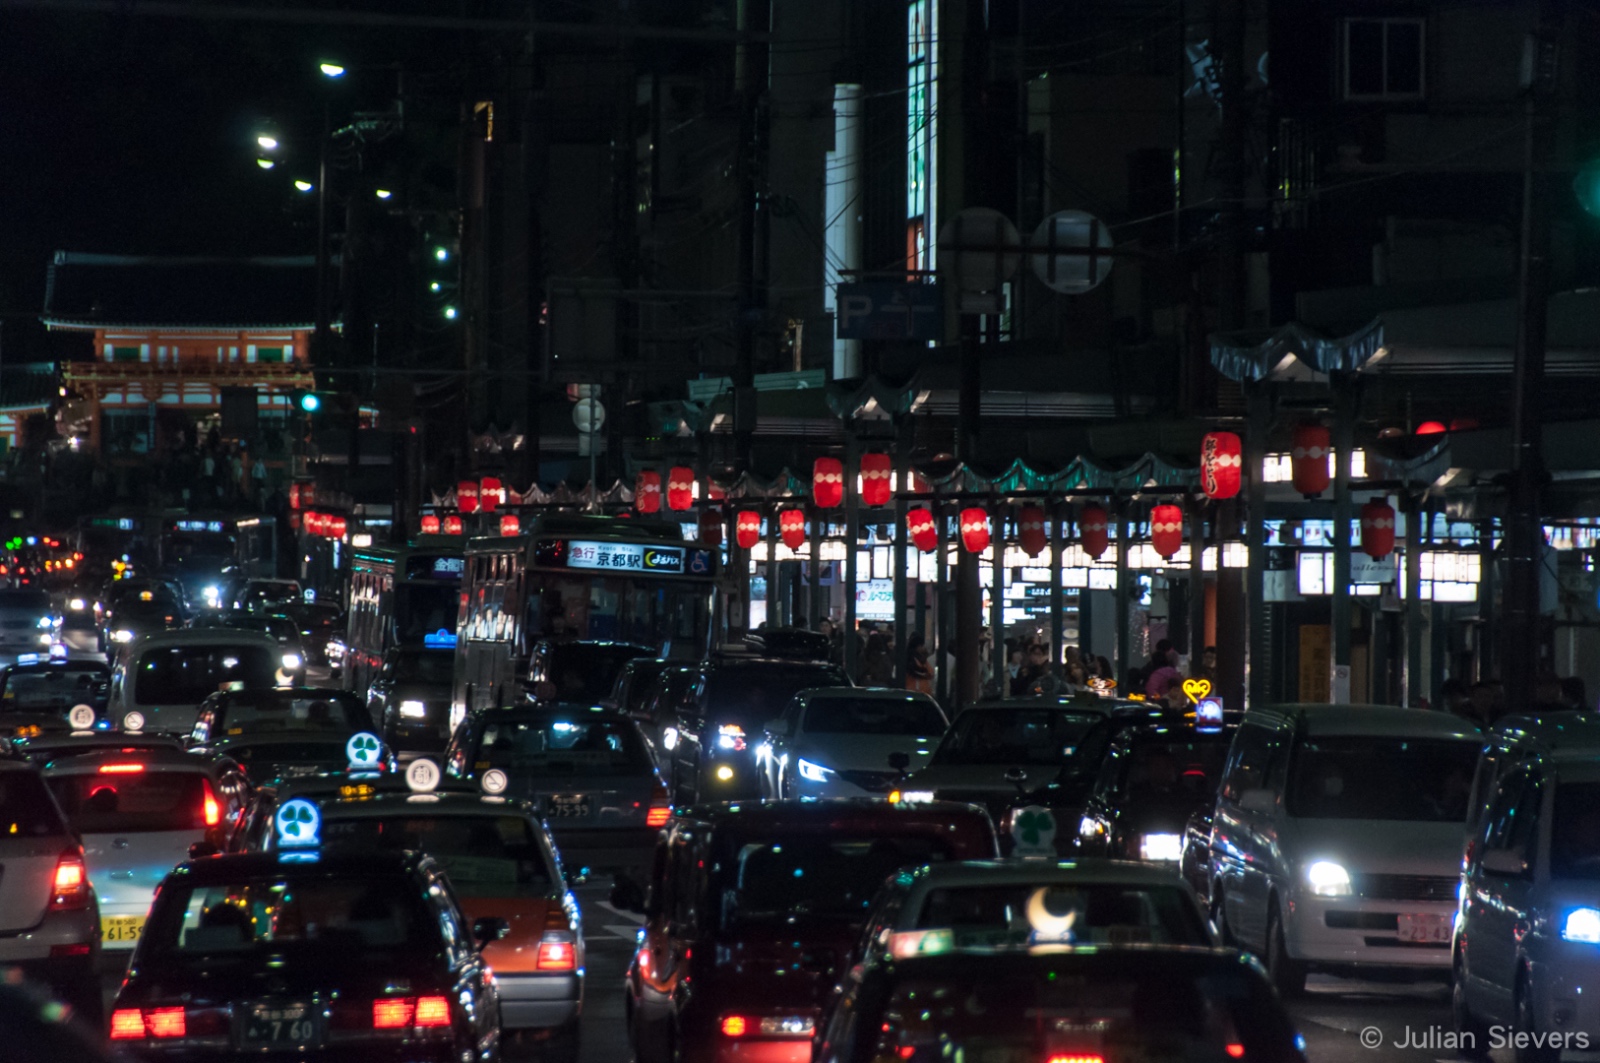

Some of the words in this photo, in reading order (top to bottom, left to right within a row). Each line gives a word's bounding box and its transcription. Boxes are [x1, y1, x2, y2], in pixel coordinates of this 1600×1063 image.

[841, 295, 873, 329] P
[571, 546, 595, 560] 急行
[597, 552, 641, 569] 京都駅
